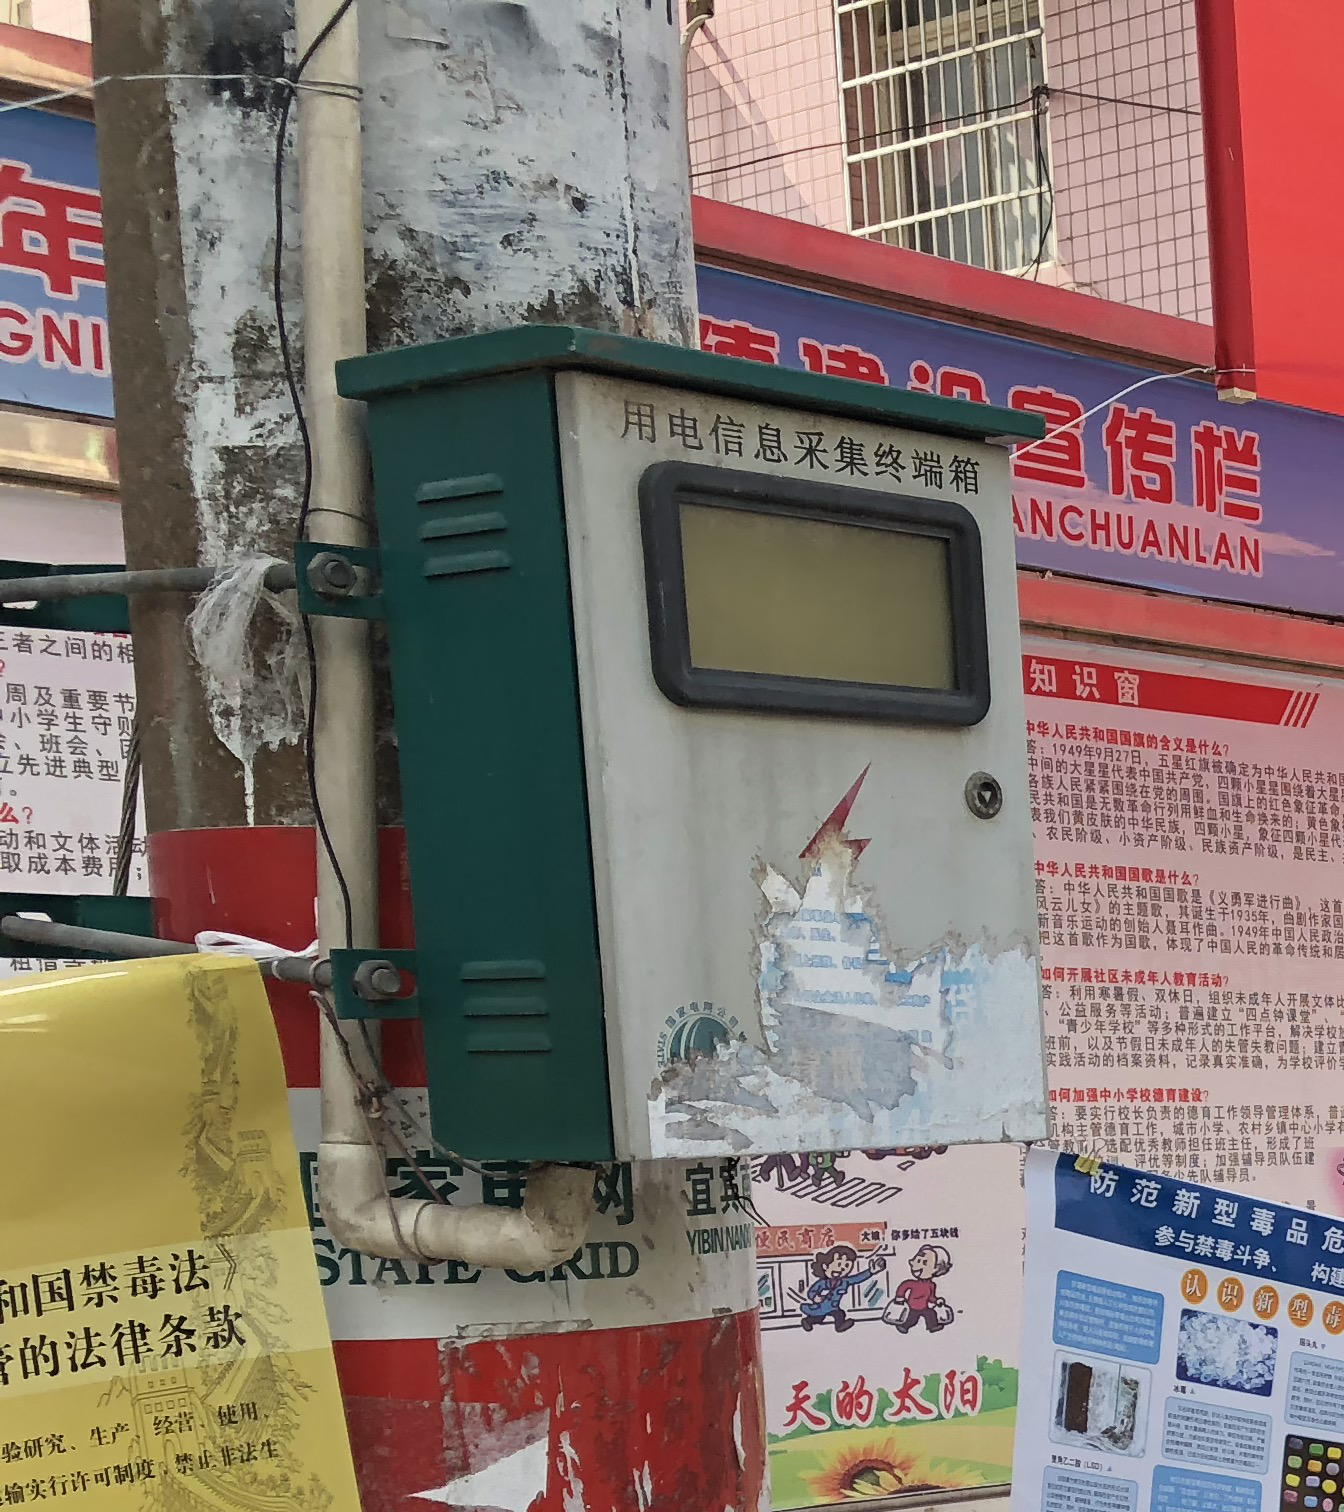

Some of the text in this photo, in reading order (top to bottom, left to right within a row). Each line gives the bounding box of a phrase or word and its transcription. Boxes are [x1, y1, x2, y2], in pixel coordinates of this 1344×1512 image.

[620, 400, 980, 496] 用电信息采集终端箱
[1029, 659, 1141, 707] 知识窗
[782, 1367, 980, 1428] 天的太阳
